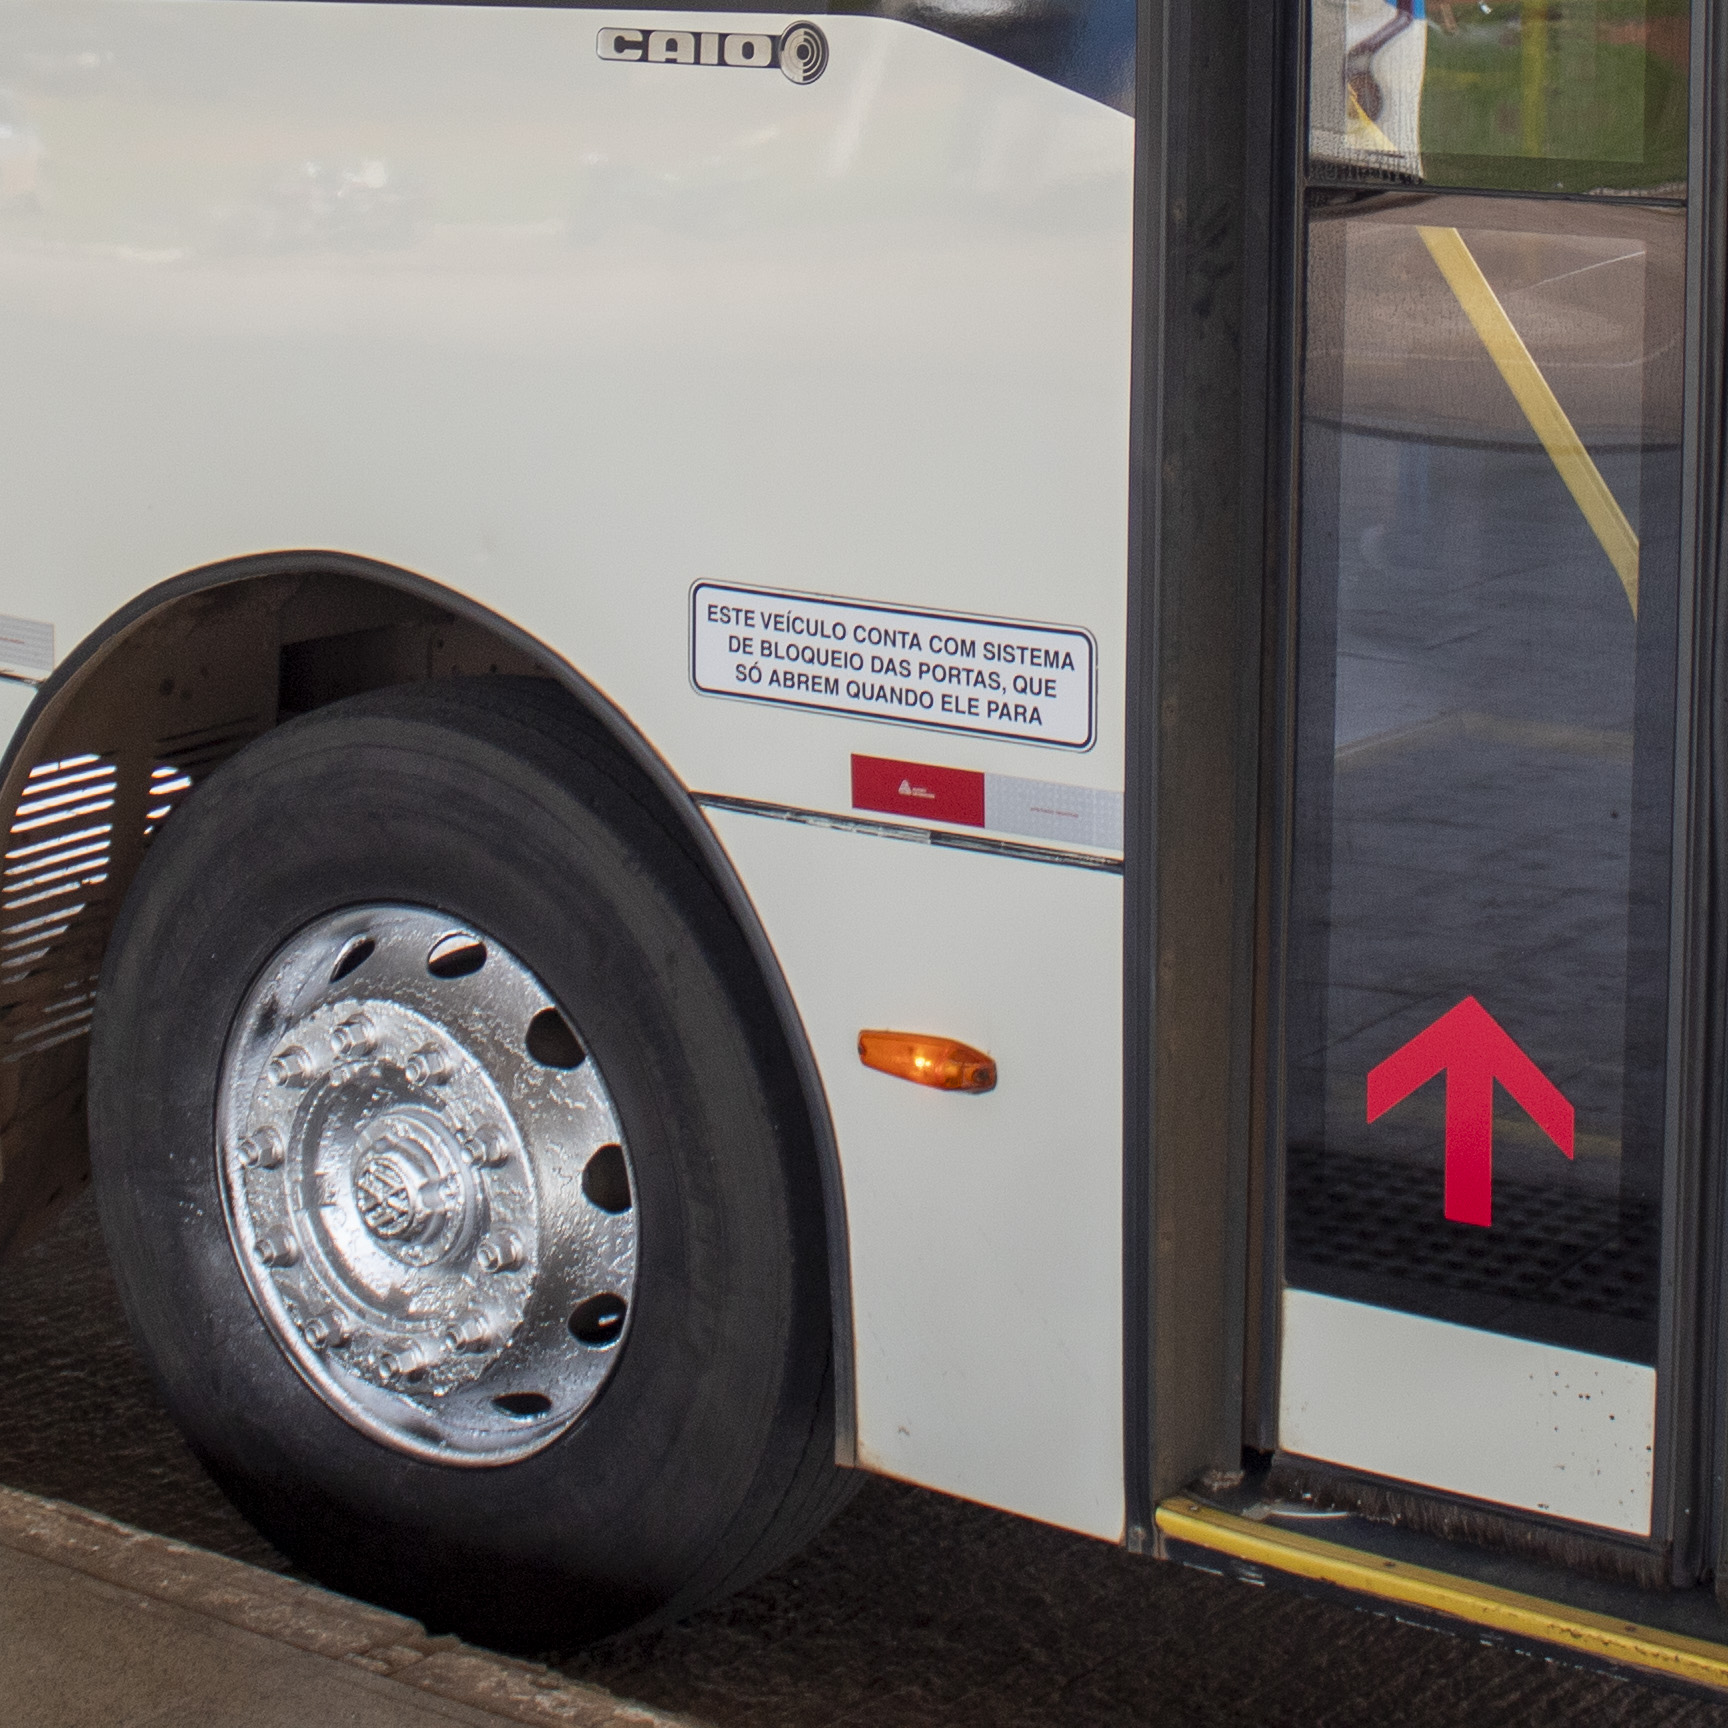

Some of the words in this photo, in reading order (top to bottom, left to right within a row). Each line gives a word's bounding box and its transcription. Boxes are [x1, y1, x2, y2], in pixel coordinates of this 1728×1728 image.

[597, 28, 772, 68] CAIO
[708, 604, 756, 628] ESTE
[760, 610, 847, 640] VEÍCULO
[854, 625, 922, 651] CONTA
[929, 635, 976, 658] COM
[984, 642, 1075, 671] SISTEMA
[728, 635, 753, 655] DE
[760, 639, 864, 671] BLOQUEIO
[871, 655, 911, 678] DAS
[919, 662, 1006, 694] PORTAS,
[1013, 674, 1057, 699] QUE
[735, 661, 762, 684] SÓ
[768, 669, 839, 696] ABREM
[846, 680, 934, 709] QUANDO
[941, 694, 980, 716] ELE
[987, 700, 1043, 726] PARA
